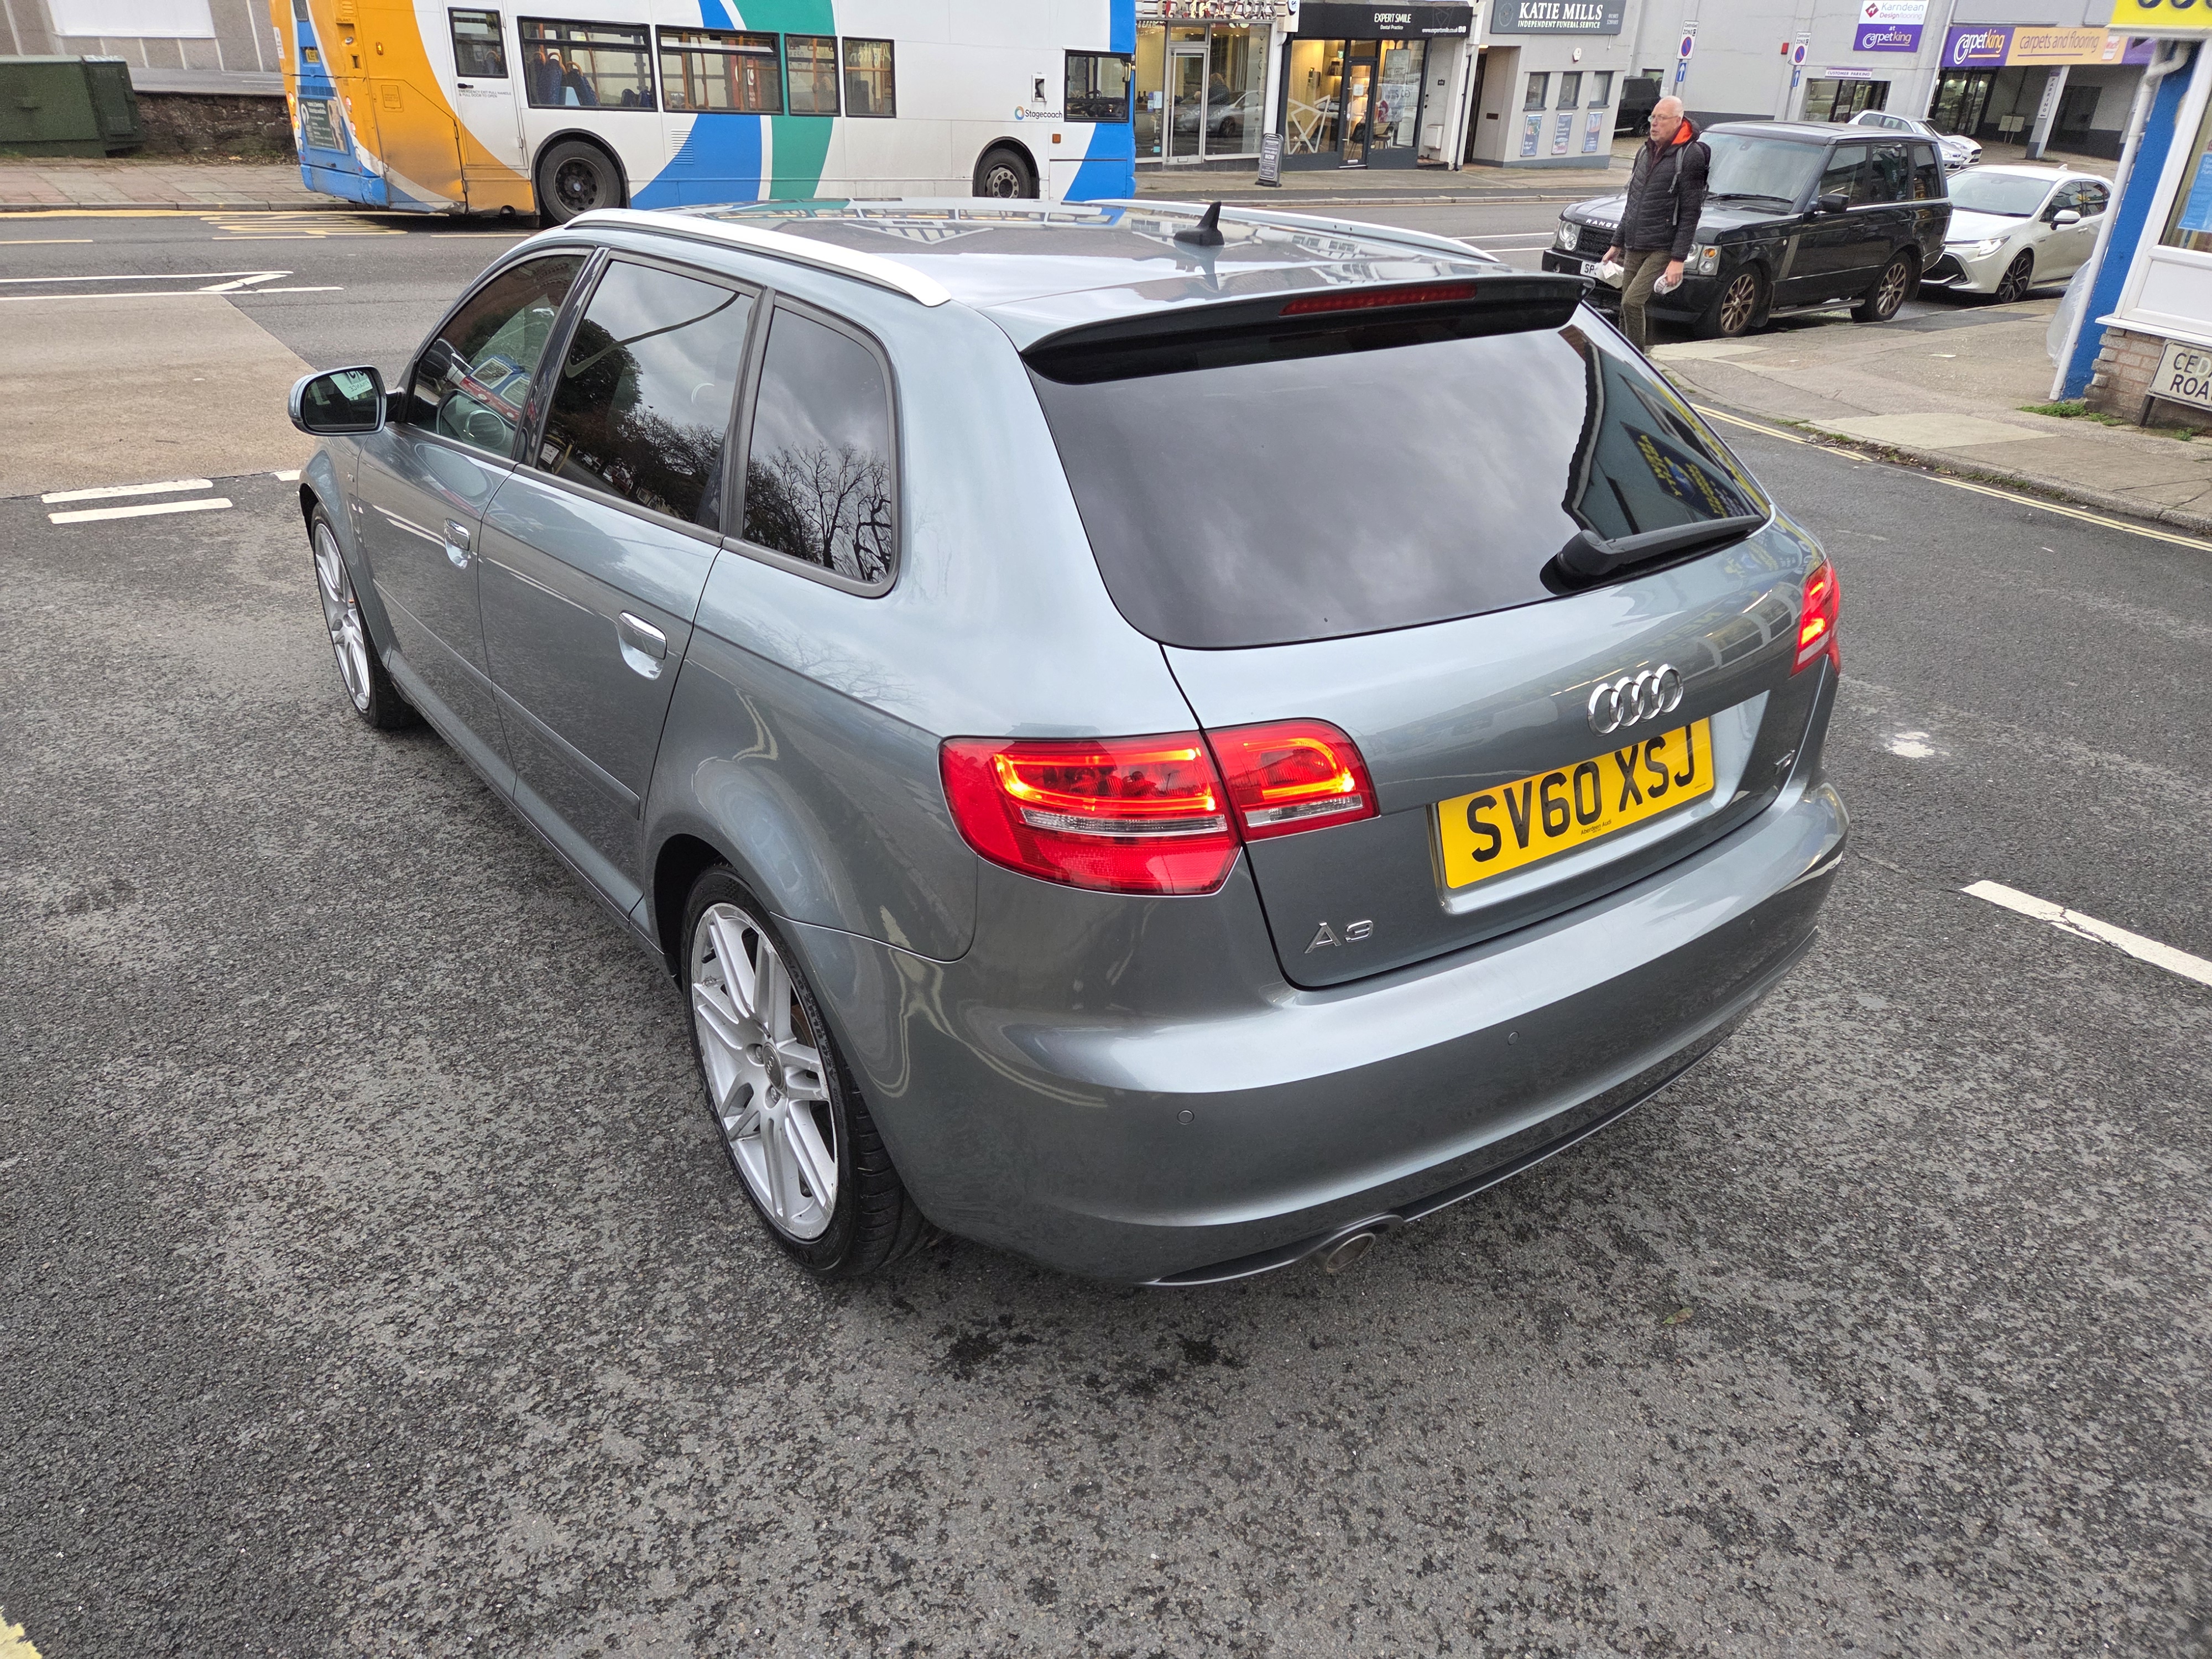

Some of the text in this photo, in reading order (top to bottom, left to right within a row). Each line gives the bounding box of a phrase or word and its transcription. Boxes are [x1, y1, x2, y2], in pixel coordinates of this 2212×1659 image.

[1519, 2, 1603, 20] KATIE MILLS
[1881, 2, 1924, 11] Karndean
[1374, 13, 1411, 23] EXPERT SMILE
[2020, 34, 2052, 54] carpets
[2052, 32, 2068, 49] and
[2069, 31, 2101, 53] flooring
[2042, 77, 2056, 112] PARKING
[1025, 109, 1063, 119] Stagecoach
[2173, 352, 2212, 378] CED
[1467, 724, 1695, 863] SV60 XSJ
[1581, 824, 1601, 836] Aberdeen
[1602, 818, 1611, 827] Audi
[1303, 920, 1374, 954] A3
